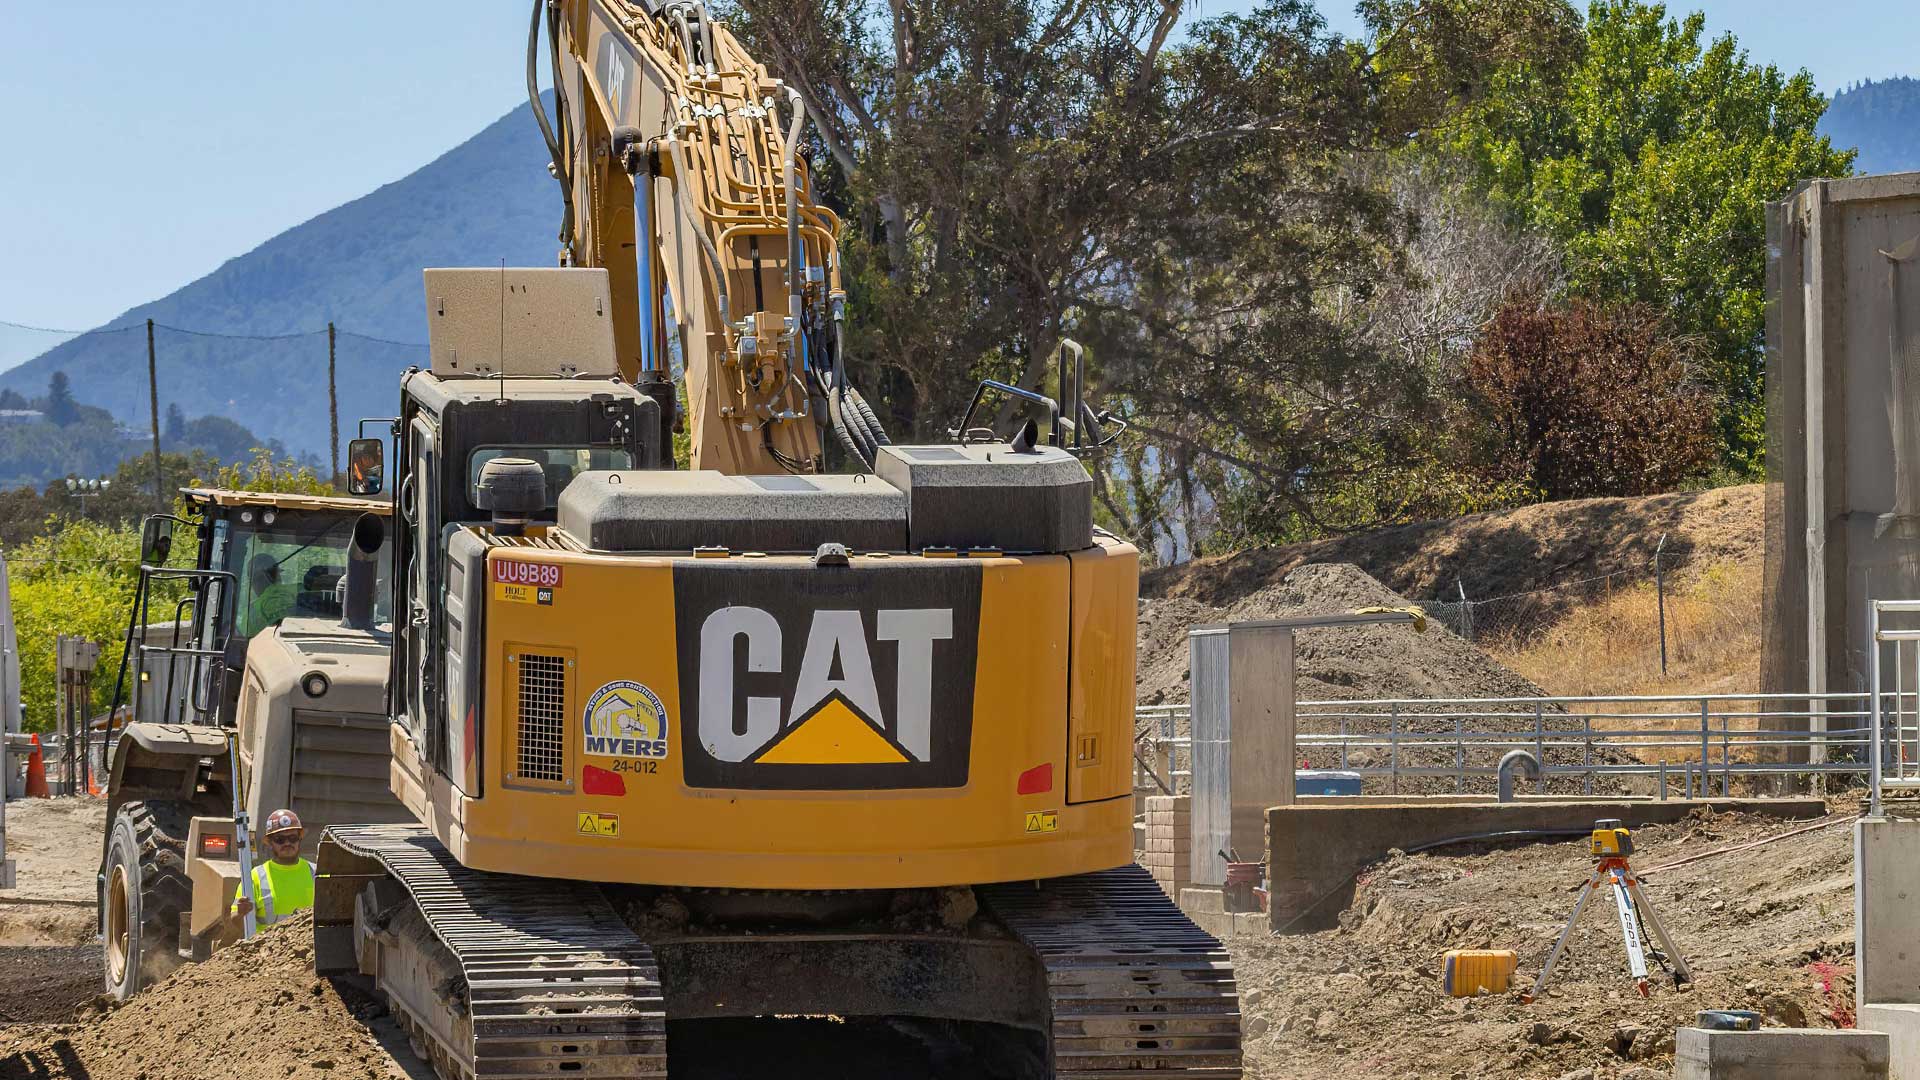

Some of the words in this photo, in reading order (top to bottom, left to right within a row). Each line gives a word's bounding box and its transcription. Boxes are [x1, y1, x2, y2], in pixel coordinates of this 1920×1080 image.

[608, 41, 624, 123] CAT
[497, 560, 559, 585] UU9B89
[538, 591, 553, 601] CAT
[699, 605, 953, 763] CAT
[586, 736, 666, 757] MYERS
[612, 759, 657, 774] 24-012
